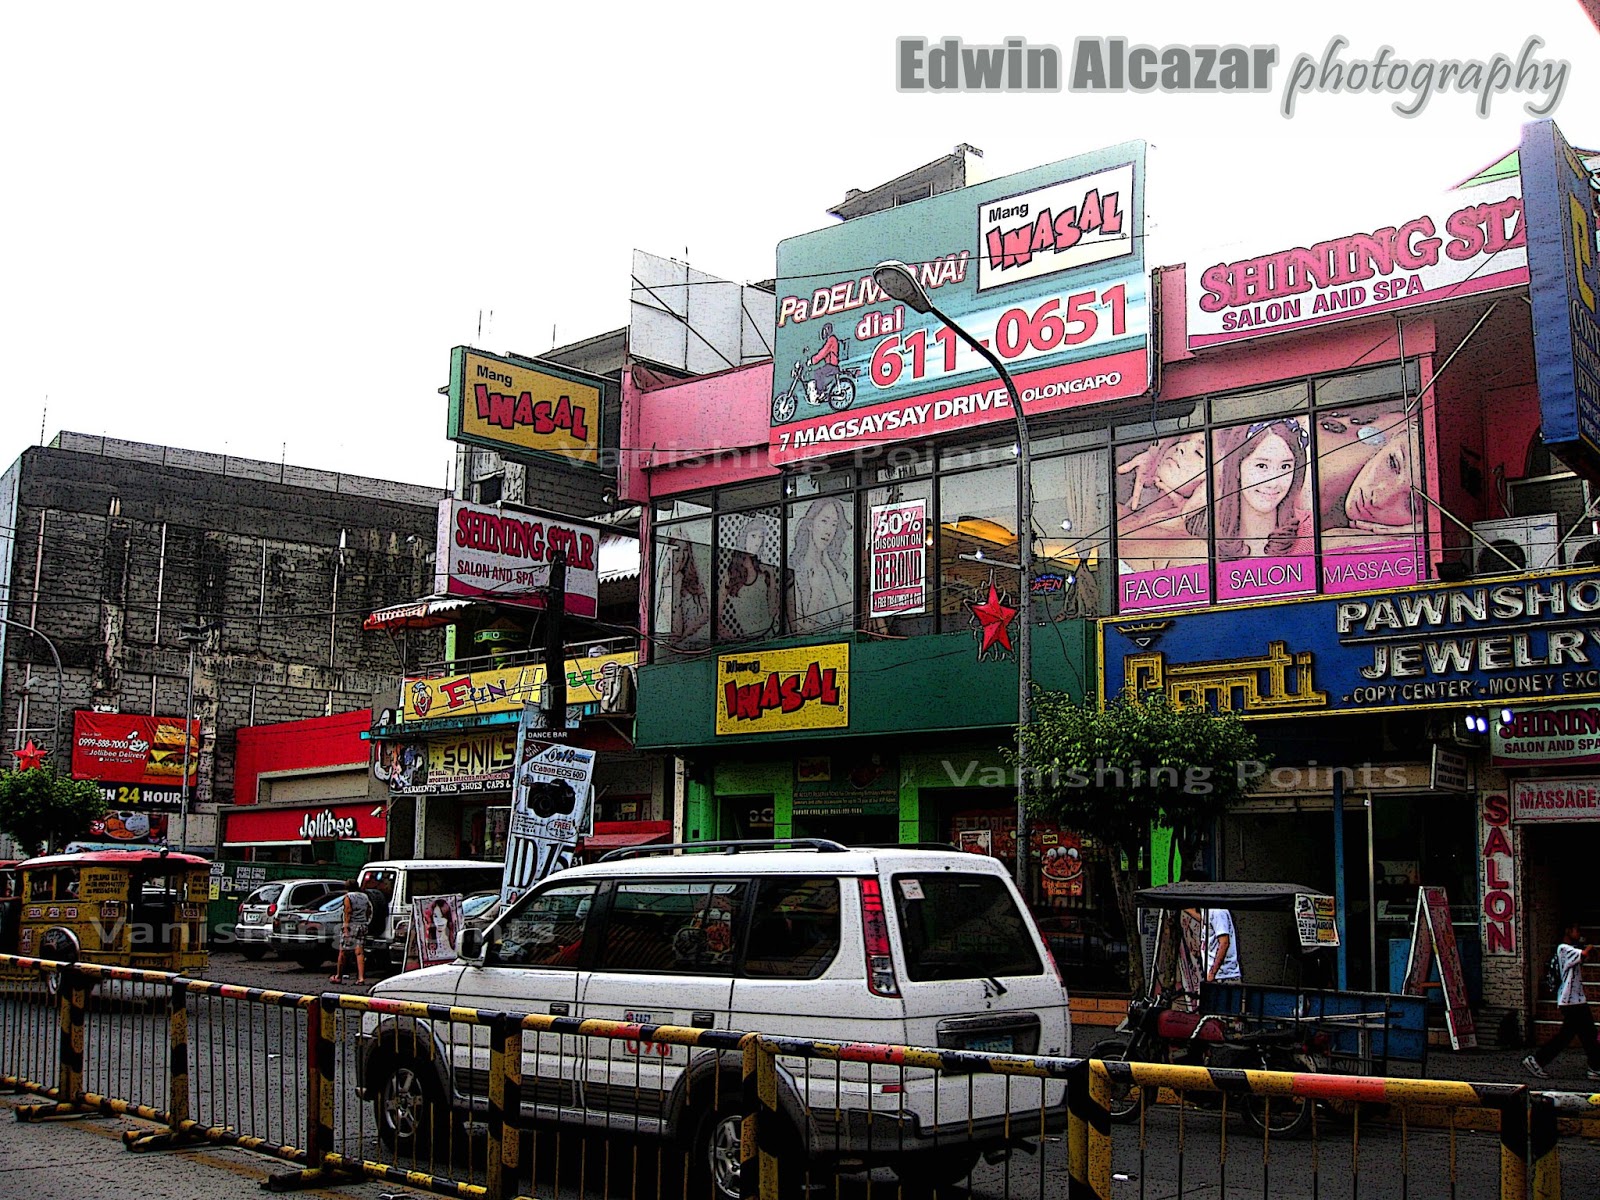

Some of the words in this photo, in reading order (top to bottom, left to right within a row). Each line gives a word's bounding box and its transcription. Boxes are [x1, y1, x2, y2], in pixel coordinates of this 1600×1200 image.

[988, 203, 1029, 224] Mang
[985, 188, 1123, 270] INASAL
[1199, 215, 1442, 312] SHINING
[778, 296, 809, 327] Pa
[920, 250, 970, 289] NA!
[1222, 299, 1301, 331] SALON
[1312, 287, 1367, 314] AND
[1373, 274, 1425, 301] SPA
[855, 305, 905, 340] dial
[476, 365, 513, 388] Mang
[473, 383, 588, 442] INASAL
[778, 433, 791, 453] 7
[793, 406, 931, 449] MAGSAYSAY
[1021, 371, 1122, 403] OLONGAPO
[455, 507, 546, 562] SHINING
[546, 525, 594, 571] STAR
[875, 535, 909, 549] DISCOUNT
[911, 533, 921, 546] ON
[457, 559, 490, 578] SALON
[491, 566, 513, 583] AND
[515, 571, 534, 587] SPA
[875, 550, 921, 590] REBOND
[1229, 563, 1303, 590] SALON
[1124, 572, 1206, 602] FACIAL
[726, 660, 760, 673] Mang
[724, 661, 840, 721] INASAL
[1353, 685, 1396, 704] COPY
[1402, 680, 1472, 701] CENTER
[1489, 673, 1554, 694] MONEY
[1499, 707, 1600, 739] SHININ
[1504, 741, 1545, 754] SALON
[1548, 739, 1574, 751] AND
[486, 780, 504, 789] CAPS
[533, 764, 556, 774] Canon
[557, 769, 573, 777] EOS
[118, 786, 140, 803] 24
[1519, 787, 1597, 810] MASSAGE
[300, 809, 354, 838] Jollibee
[1483, 795, 1514, 953] SALON
